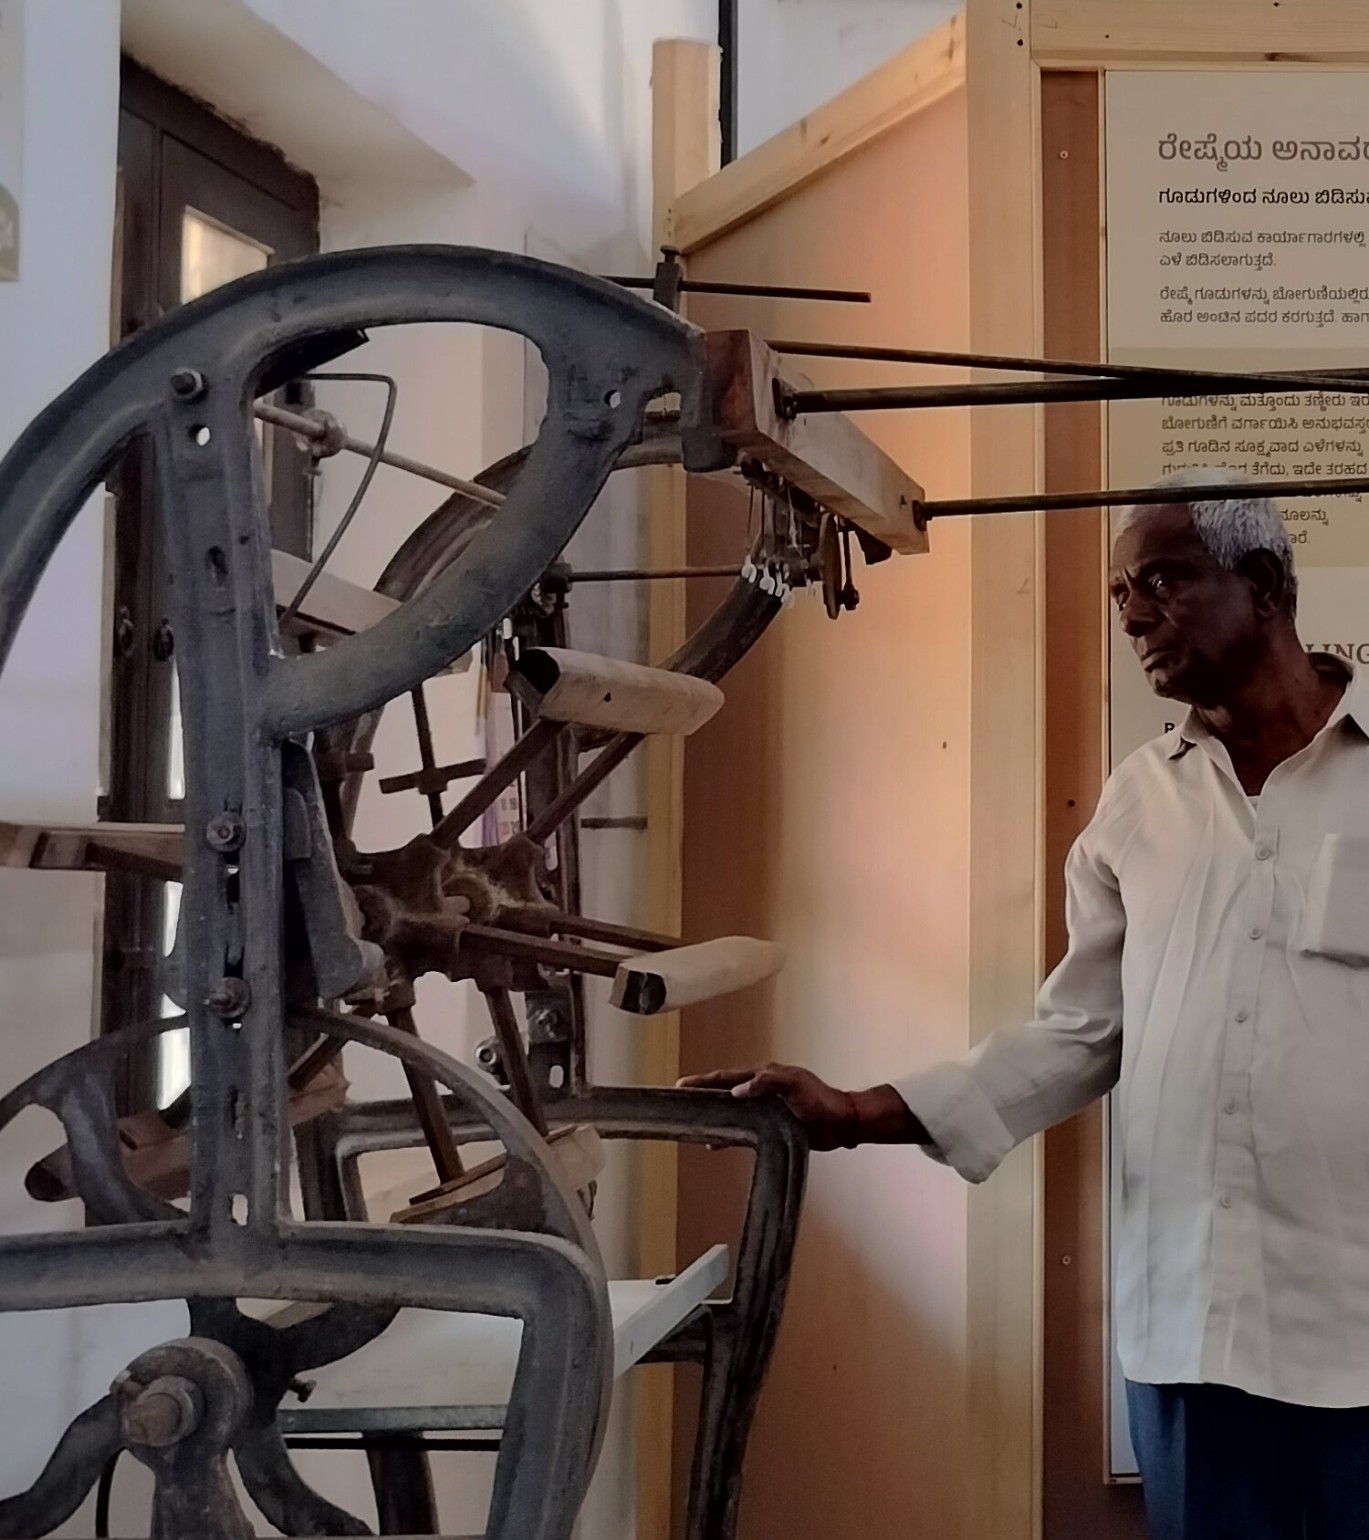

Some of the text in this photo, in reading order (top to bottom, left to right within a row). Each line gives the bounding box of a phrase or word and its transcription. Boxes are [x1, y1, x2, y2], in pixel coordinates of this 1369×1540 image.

[1159, 133, 1262, 172] ರೇಷ್ಮೆಯ
[1159, 188, 1256, 204] ಗೂಡುಗಳಿಂದ
[1263, 189, 1309, 204] ನೂಲು
[1159, 230, 1197, 244] ನೂಲು
[1201, 230, 1253, 244] ಬಿಡಿಸುವ
[1160, 252, 1182, 266] ಎಳೆ
